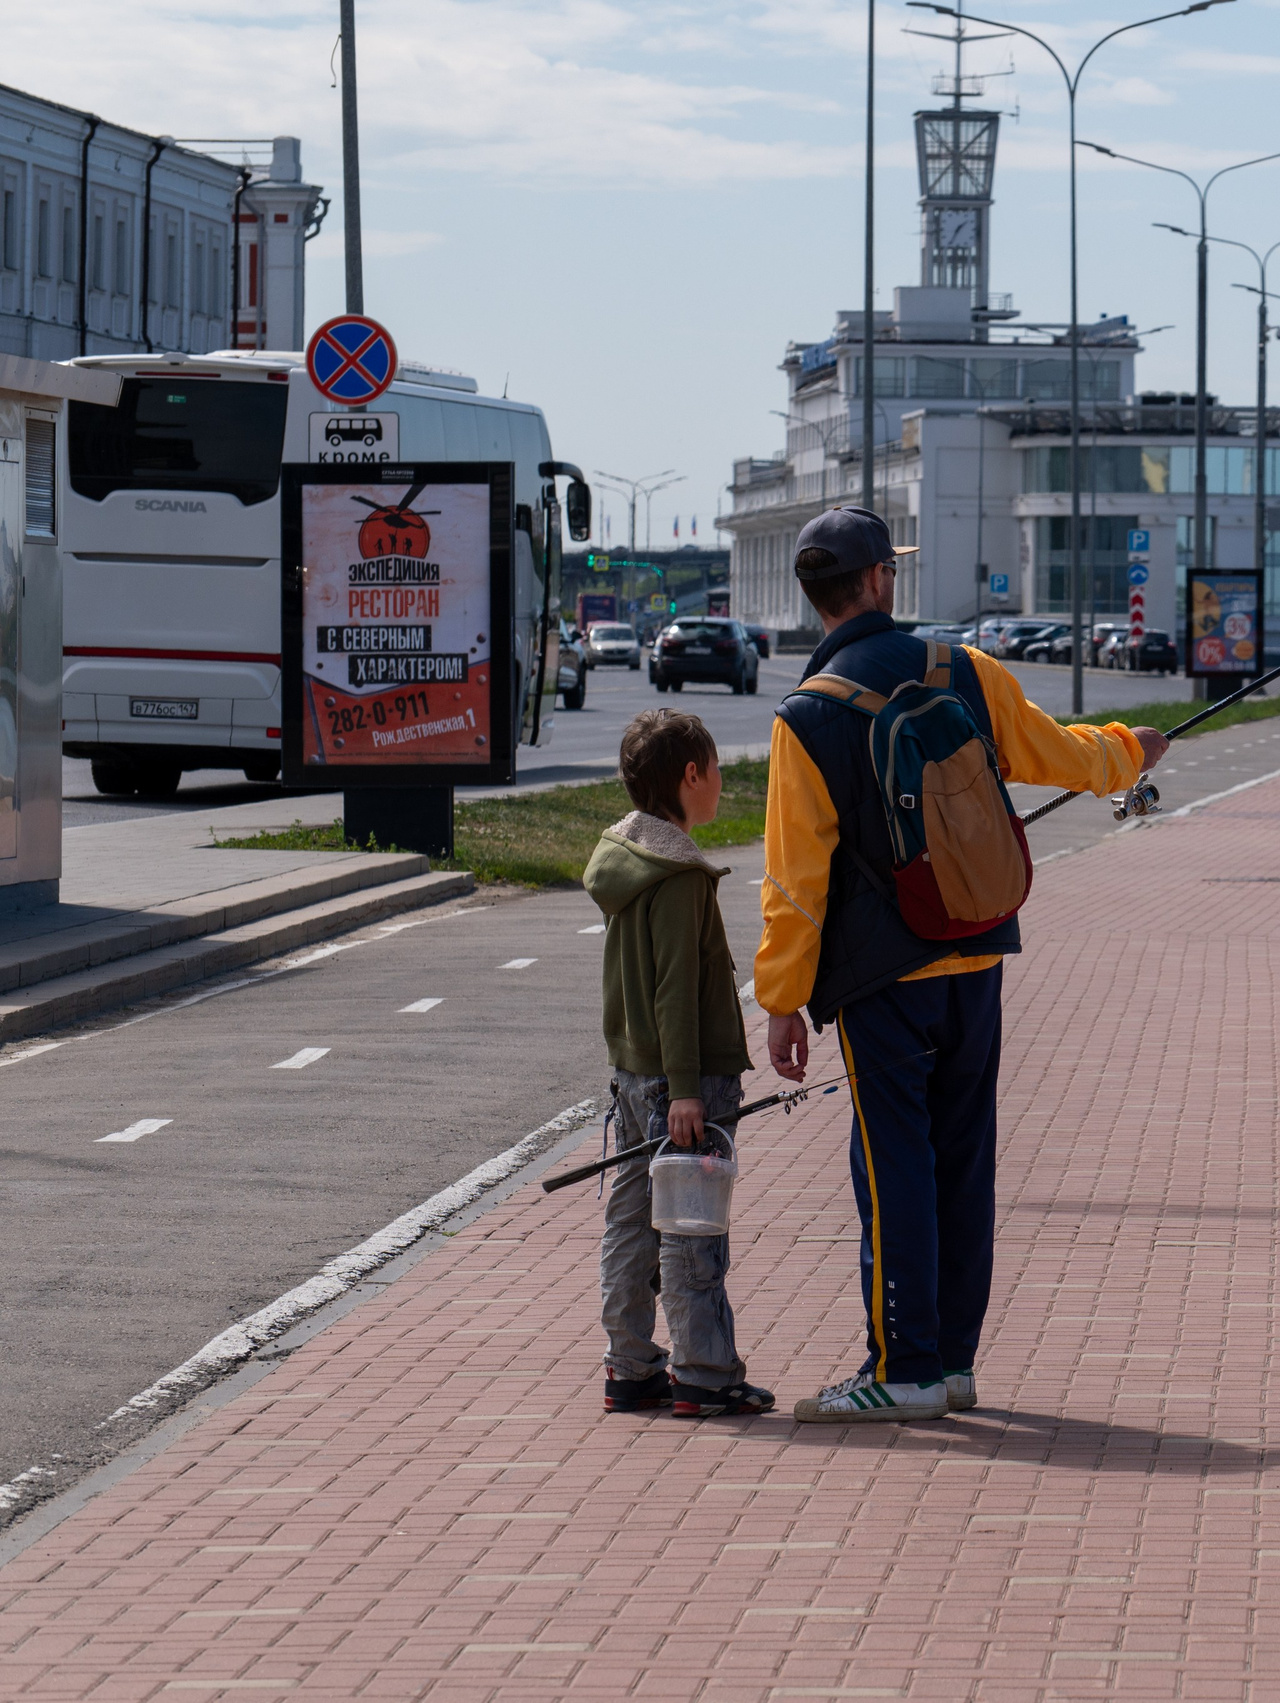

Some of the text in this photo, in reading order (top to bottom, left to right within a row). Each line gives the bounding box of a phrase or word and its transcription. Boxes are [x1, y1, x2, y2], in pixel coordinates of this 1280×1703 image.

[318, 451, 390, 463] кроме
[134, 498, 207, 513] SCANIA
[348, 557, 440, 582] ЭКСПЕДИЦИЯ
[348, 589, 439, 618] РЕСТОРАН
[326, 627, 425, 650] С СЕВЕРНЫМ
[1198, 642, 1224, 663] 0%
[357, 655, 463, 680] ХАРАКТЕРОМ!
[466, 708, 476, 728] 1
[888, 1280, 898, 1339] NIKE
